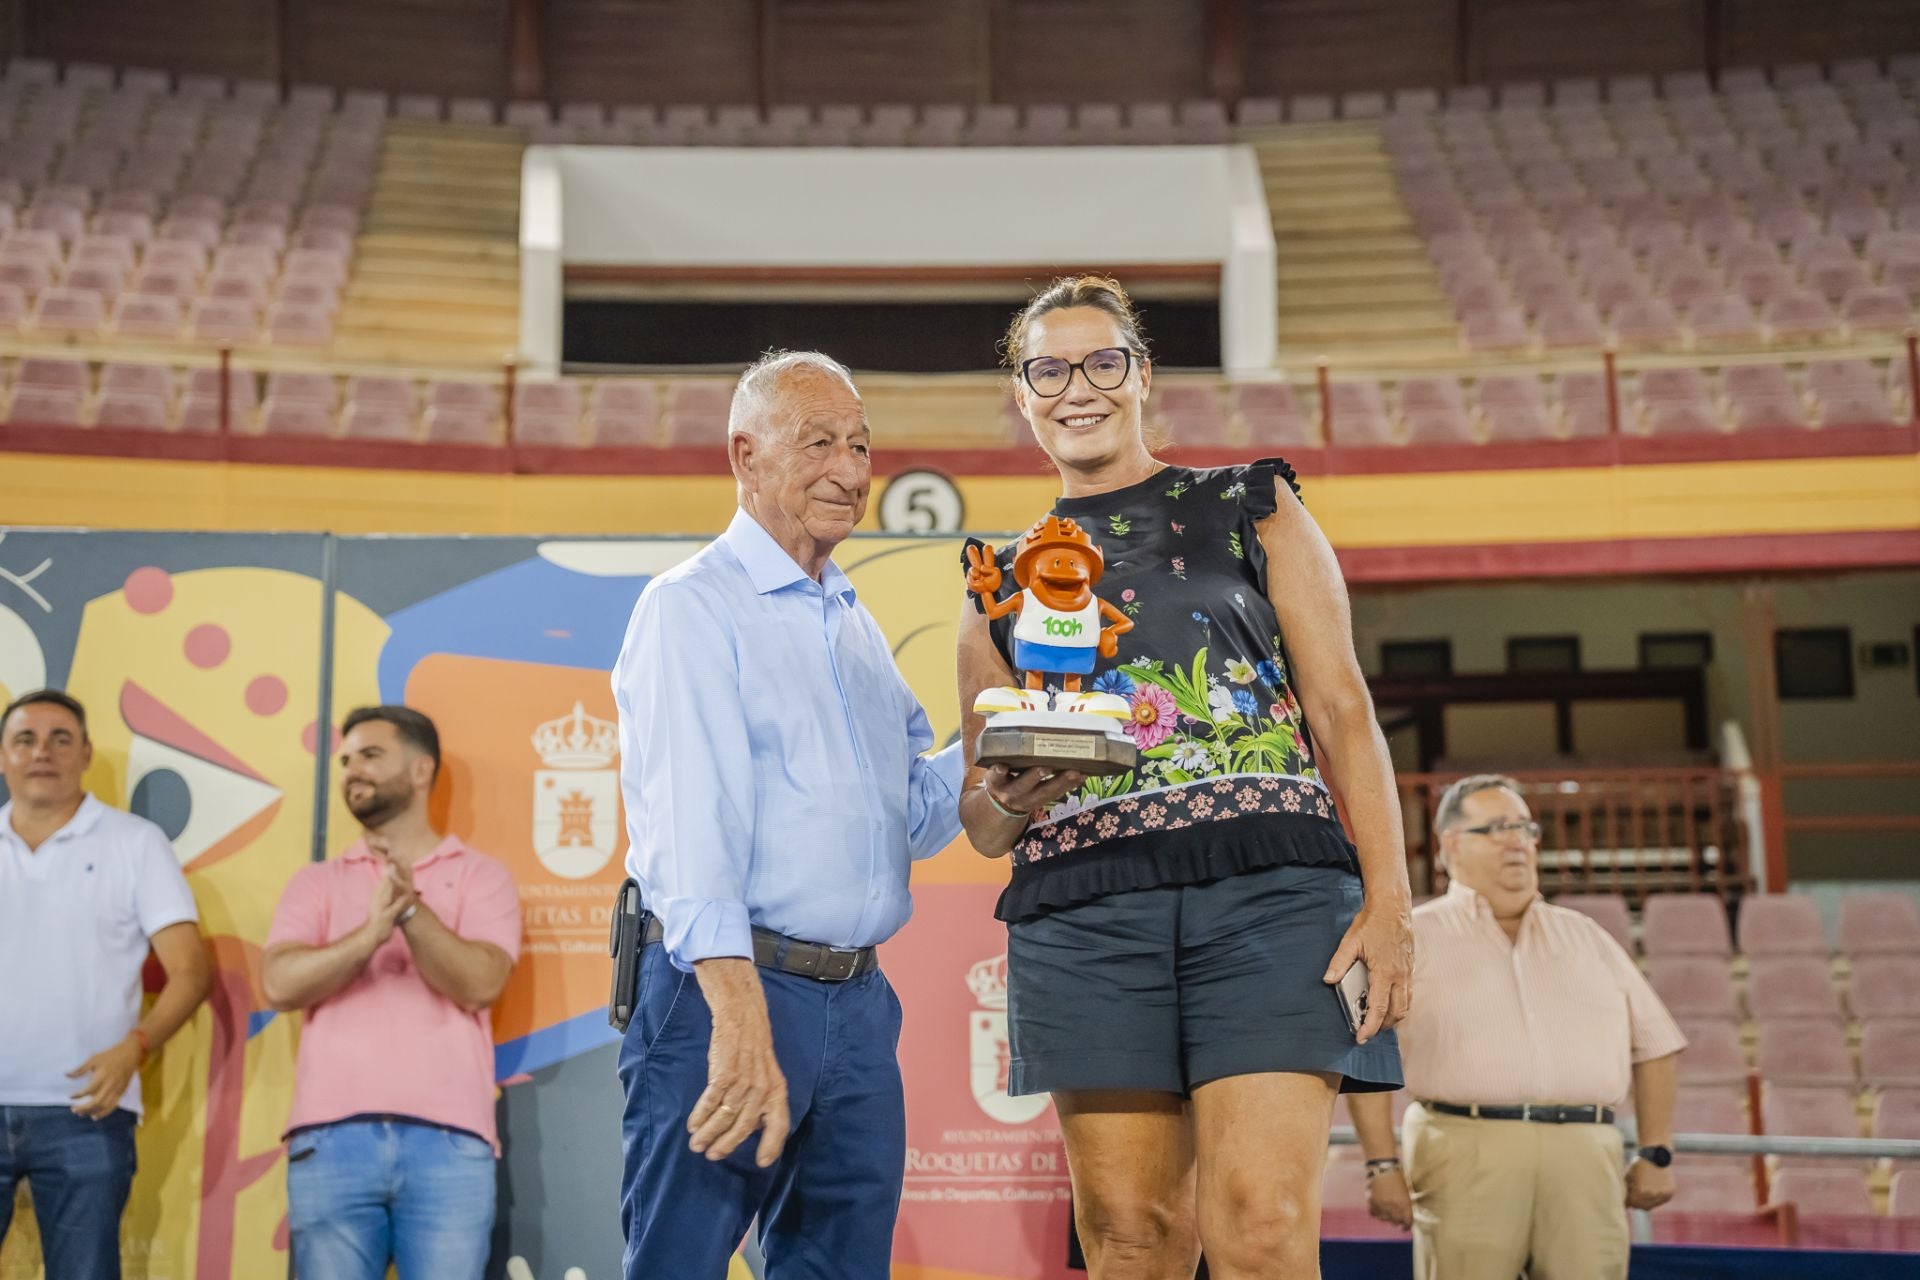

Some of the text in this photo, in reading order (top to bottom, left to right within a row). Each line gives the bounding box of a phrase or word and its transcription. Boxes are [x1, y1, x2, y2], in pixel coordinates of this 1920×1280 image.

[907, 488, 937, 532] 5
[1042, 616, 1083, 637] 100h
[905, 1148, 1023, 1175] ROQUETAS
